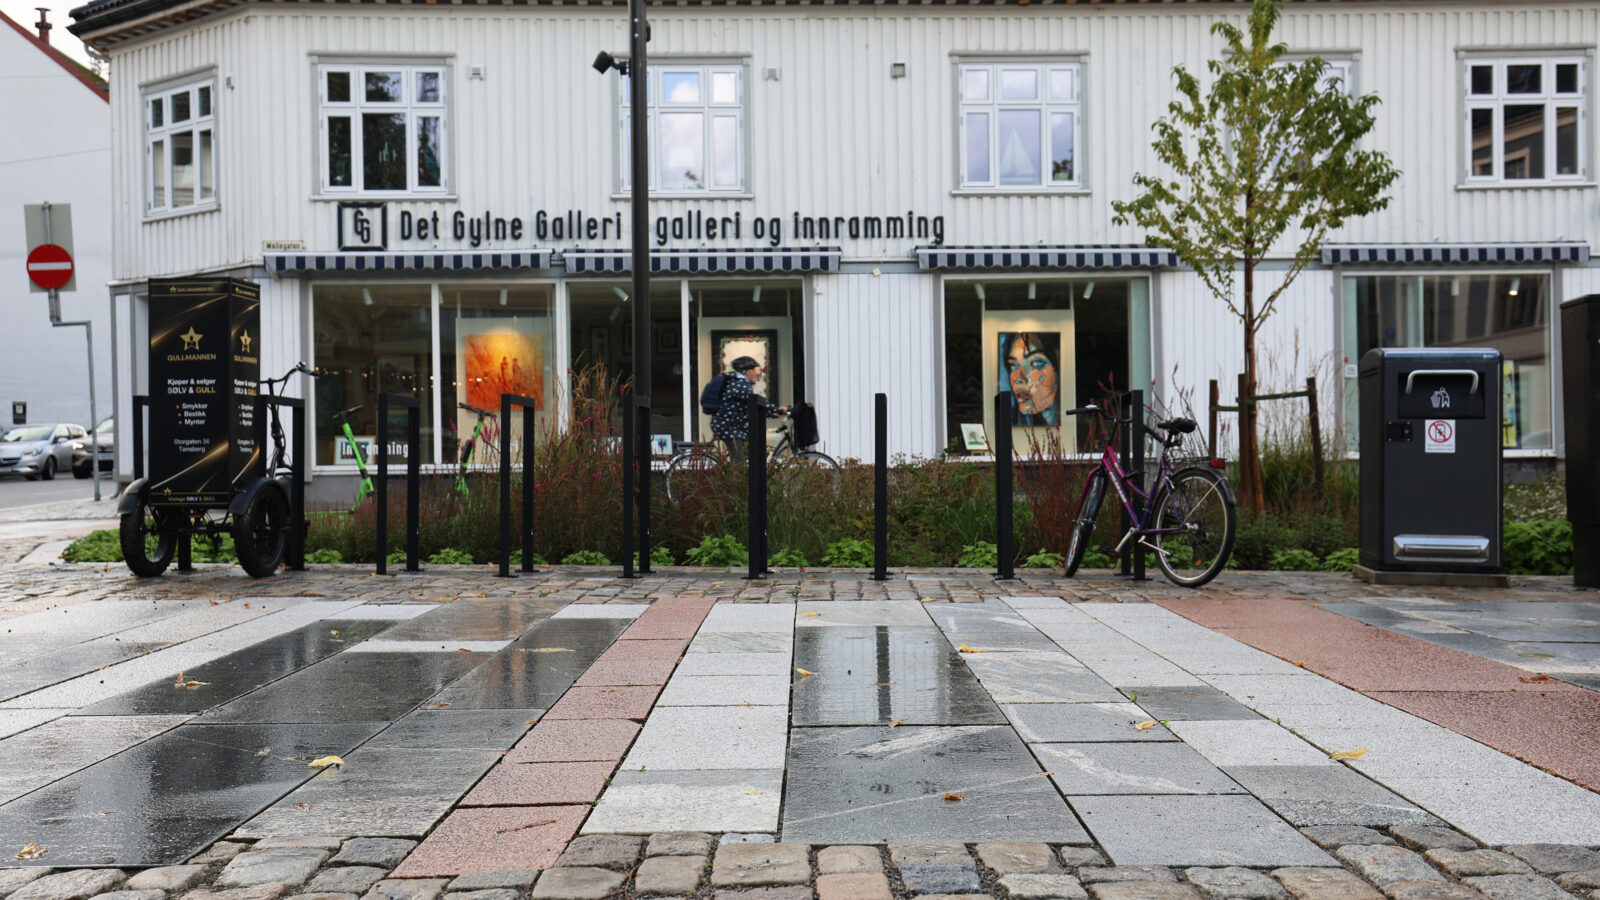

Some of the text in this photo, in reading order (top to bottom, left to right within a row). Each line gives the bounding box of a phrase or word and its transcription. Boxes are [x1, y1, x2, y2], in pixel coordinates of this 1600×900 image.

[401, 210, 944, 247] Det Gylne Galleri galleri og innramming
[167, 353, 217, 361] GULLMANNEN
[167, 378, 189, 386] Kjøper
[196, 378, 216, 386] selger
[342, 441, 409, 458] Inaming
